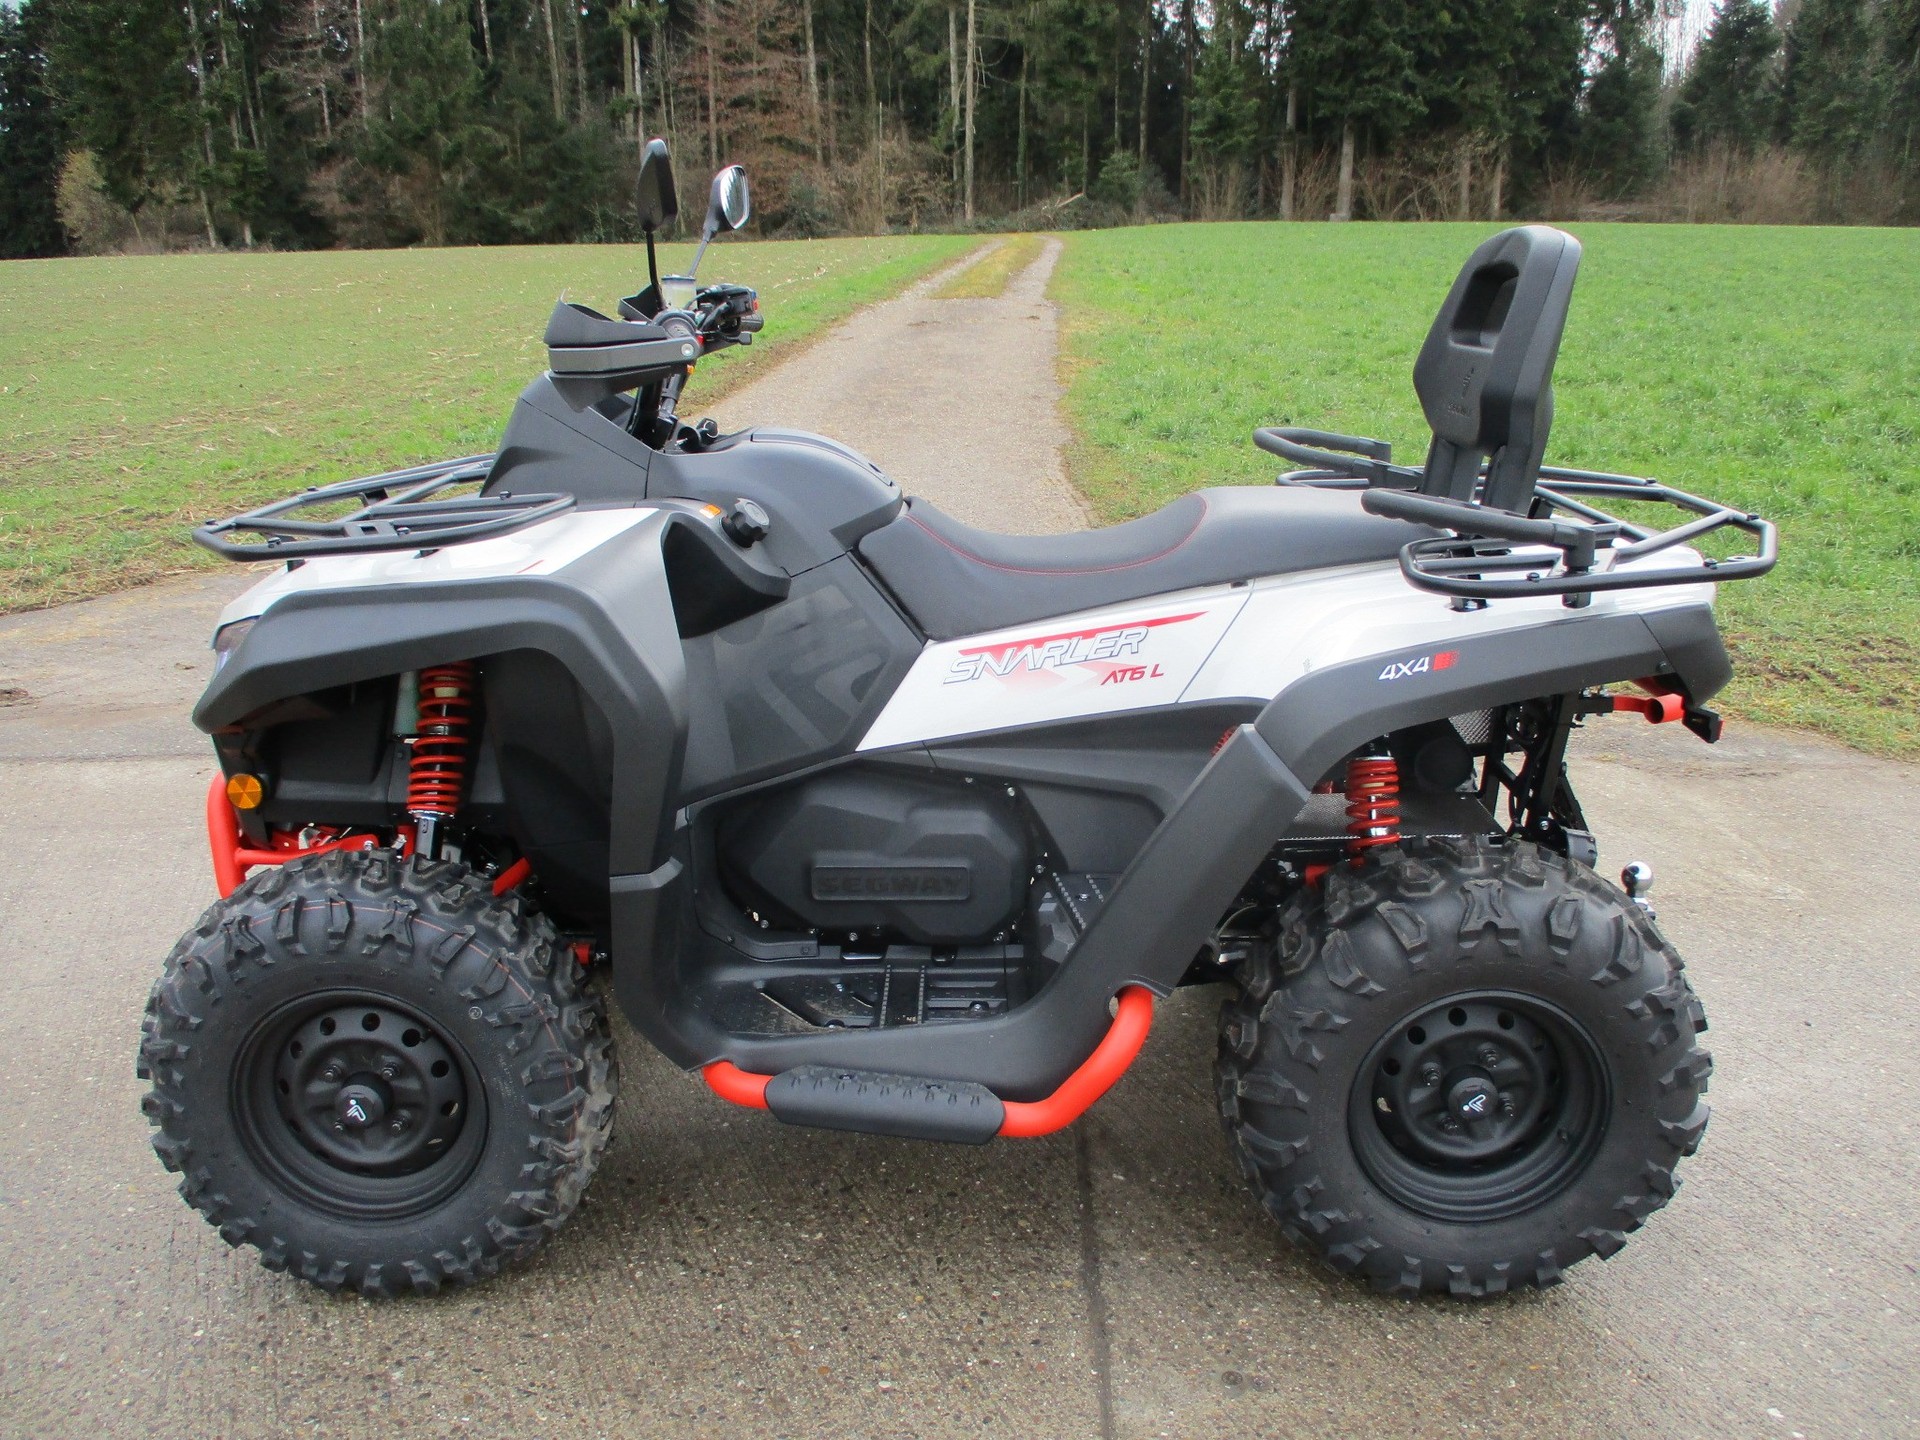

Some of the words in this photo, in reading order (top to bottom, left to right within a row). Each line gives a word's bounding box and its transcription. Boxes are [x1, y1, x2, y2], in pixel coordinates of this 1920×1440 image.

[943, 626, 1148, 684] SNARLER
[1150, 663, 1164, 678] L
[817, 875, 964, 894] SEGWAY
